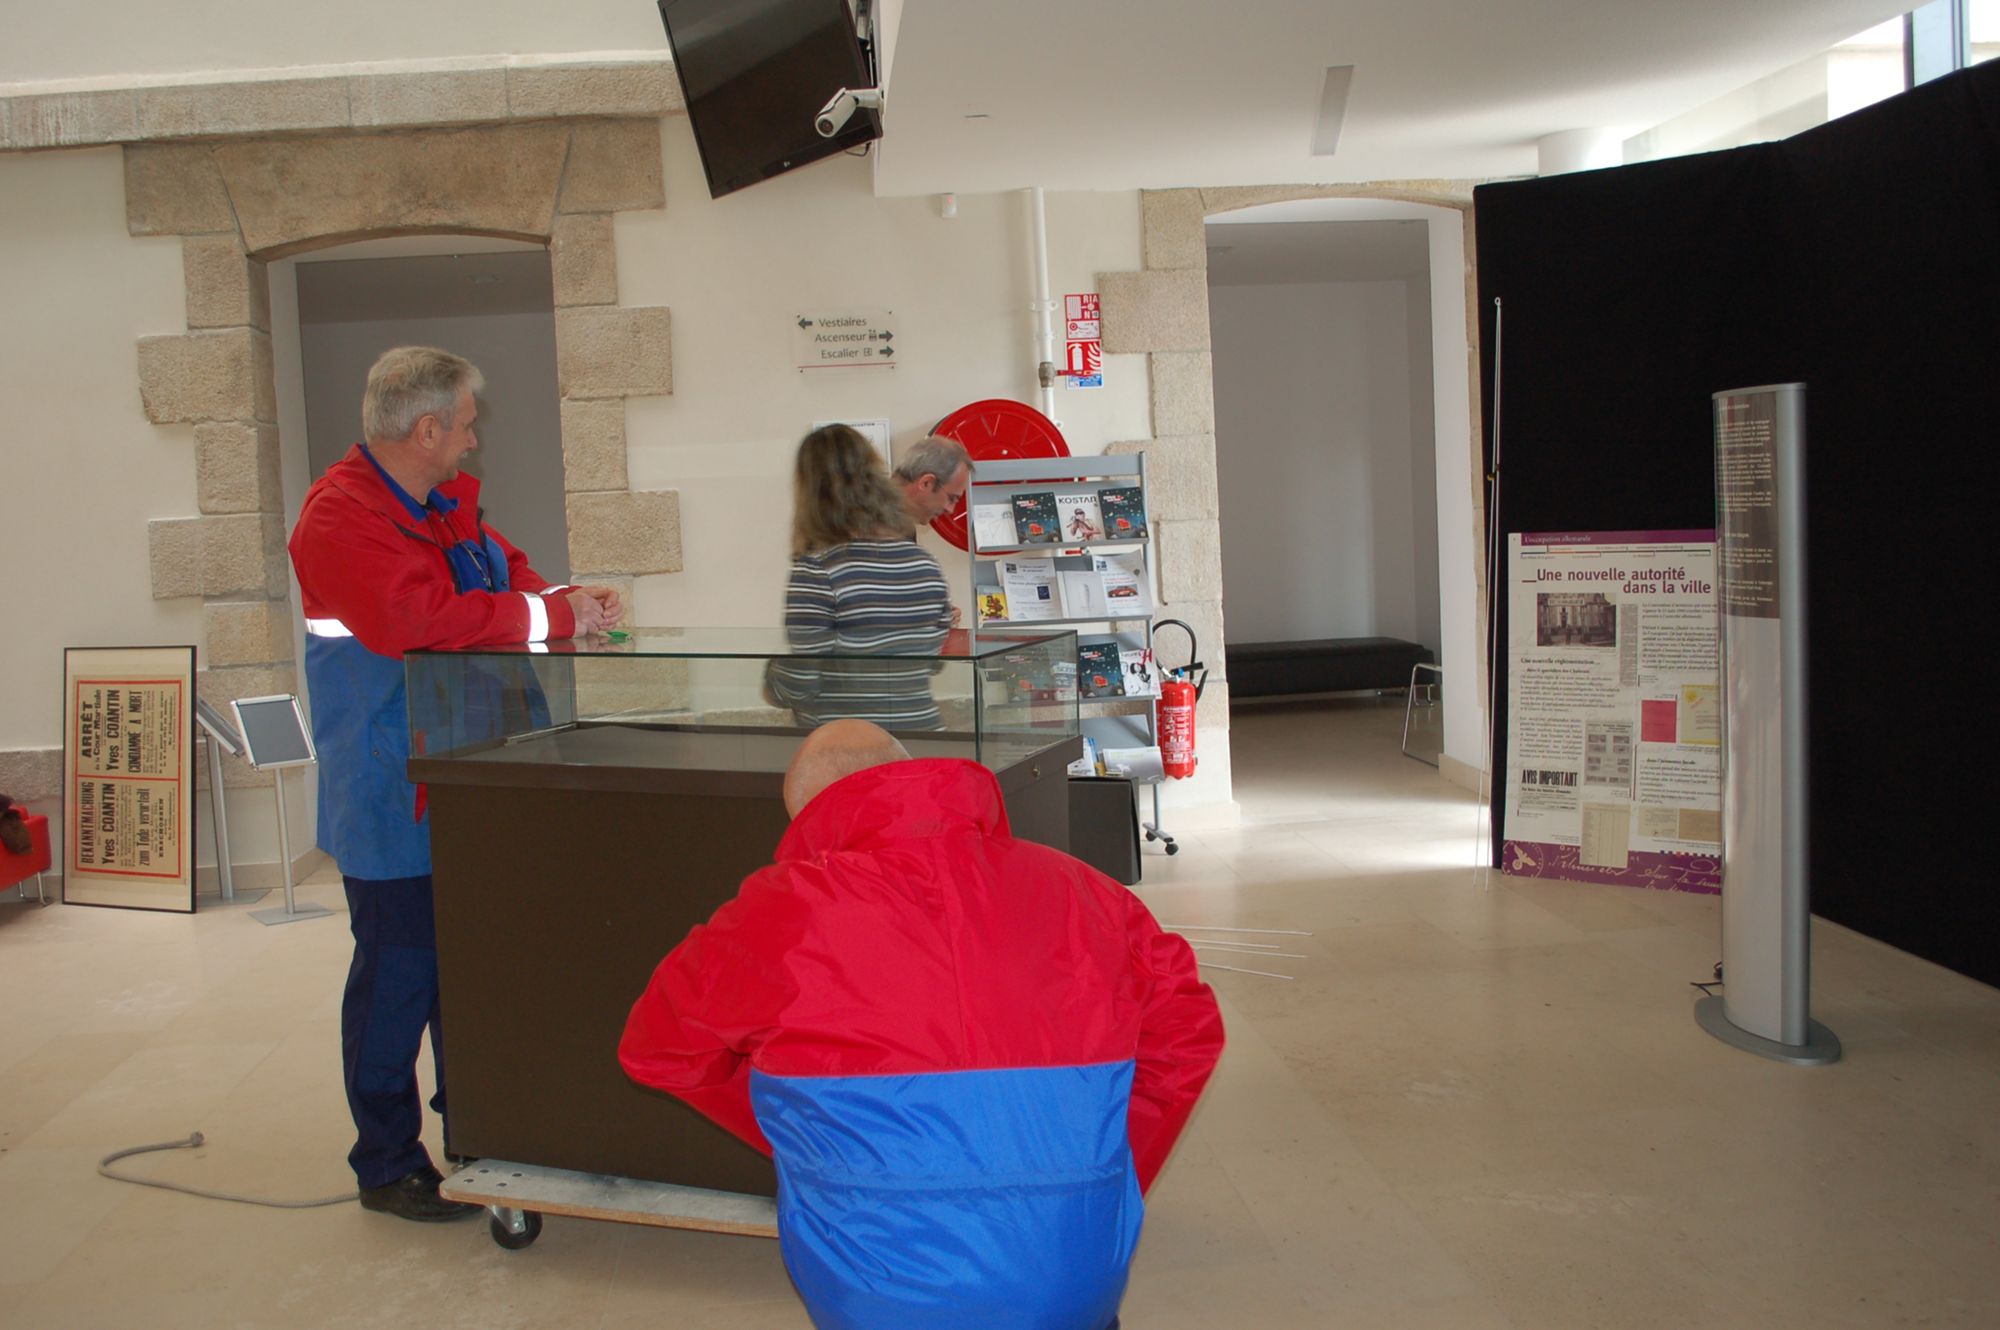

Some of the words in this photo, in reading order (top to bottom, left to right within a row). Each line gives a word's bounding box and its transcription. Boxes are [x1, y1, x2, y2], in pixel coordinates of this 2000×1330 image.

[819, 317, 868, 328] Vestiaires
[814, 333, 866, 343] Ascenseur
[820, 348, 859, 360] Escalier
[1537, 568, 1562, 581] Une
[1567, 567, 1626, 581] nouvelle
[1631, 566, 1686, 581] autorité
[1623, 580, 1657, 594] dans
[1662, 580, 1675, 593] la
[1680, 580, 1711, 593] ville
[129, 690, 142, 713] MORT
[108, 689, 120, 738] COANTIN
[81, 701, 93, 758] ARRÊT
[107, 744, 119, 771] Yves
[1521, 769, 1537, 785] AVIS
[1538, 770, 1578, 787] IMPORTANT
[103, 783, 115, 832] COANTIN
[81, 781, 94, 864] BEKANNTMACHUNG
[103, 839, 115, 865] Yves
